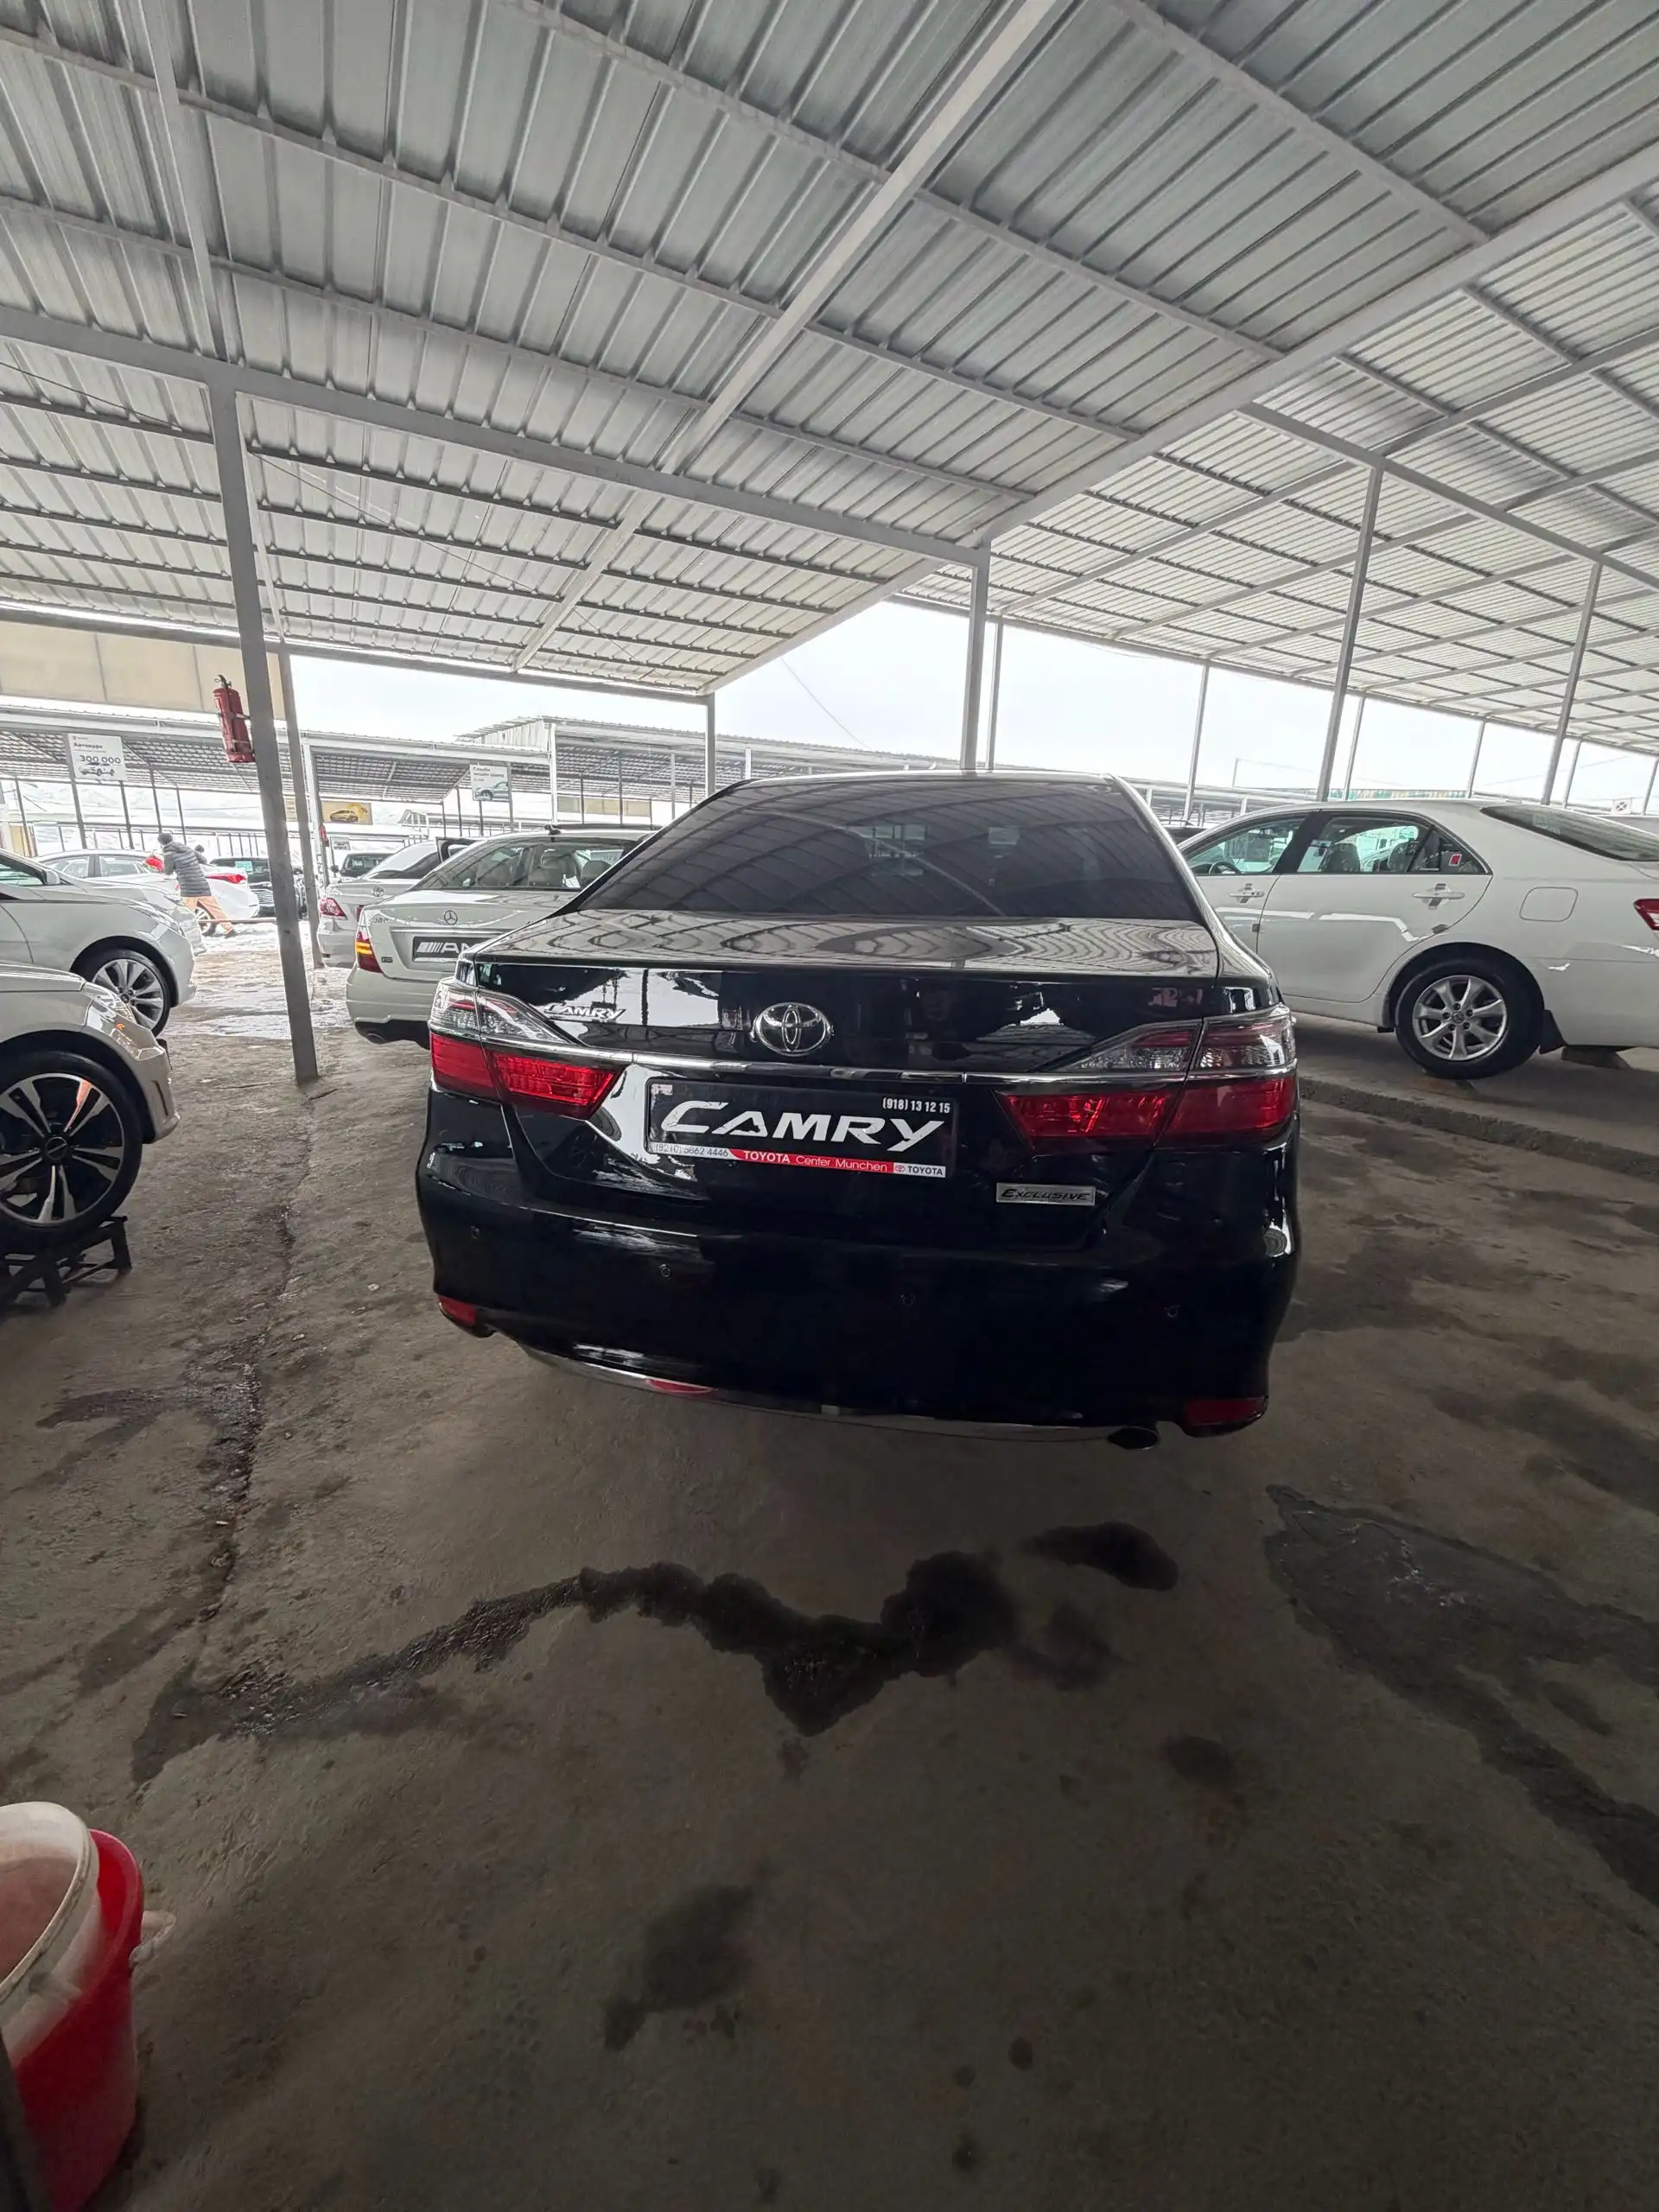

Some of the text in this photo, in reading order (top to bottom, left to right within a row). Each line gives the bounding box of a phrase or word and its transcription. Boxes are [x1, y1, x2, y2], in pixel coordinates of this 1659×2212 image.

[79, 754, 99, 763] 300
[543, 1002, 626, 1020] CAMRY
[882, 1096, 950, 1114] (918) 13 12 15
[661, 1100, 945, 1153] CAMRY
[707, 1147, 729, 1157] 4446
[743, 1150, 887, 1173] TOYOTA Center Munchen
[906, 1165, 944, 1176] TOYOTA
